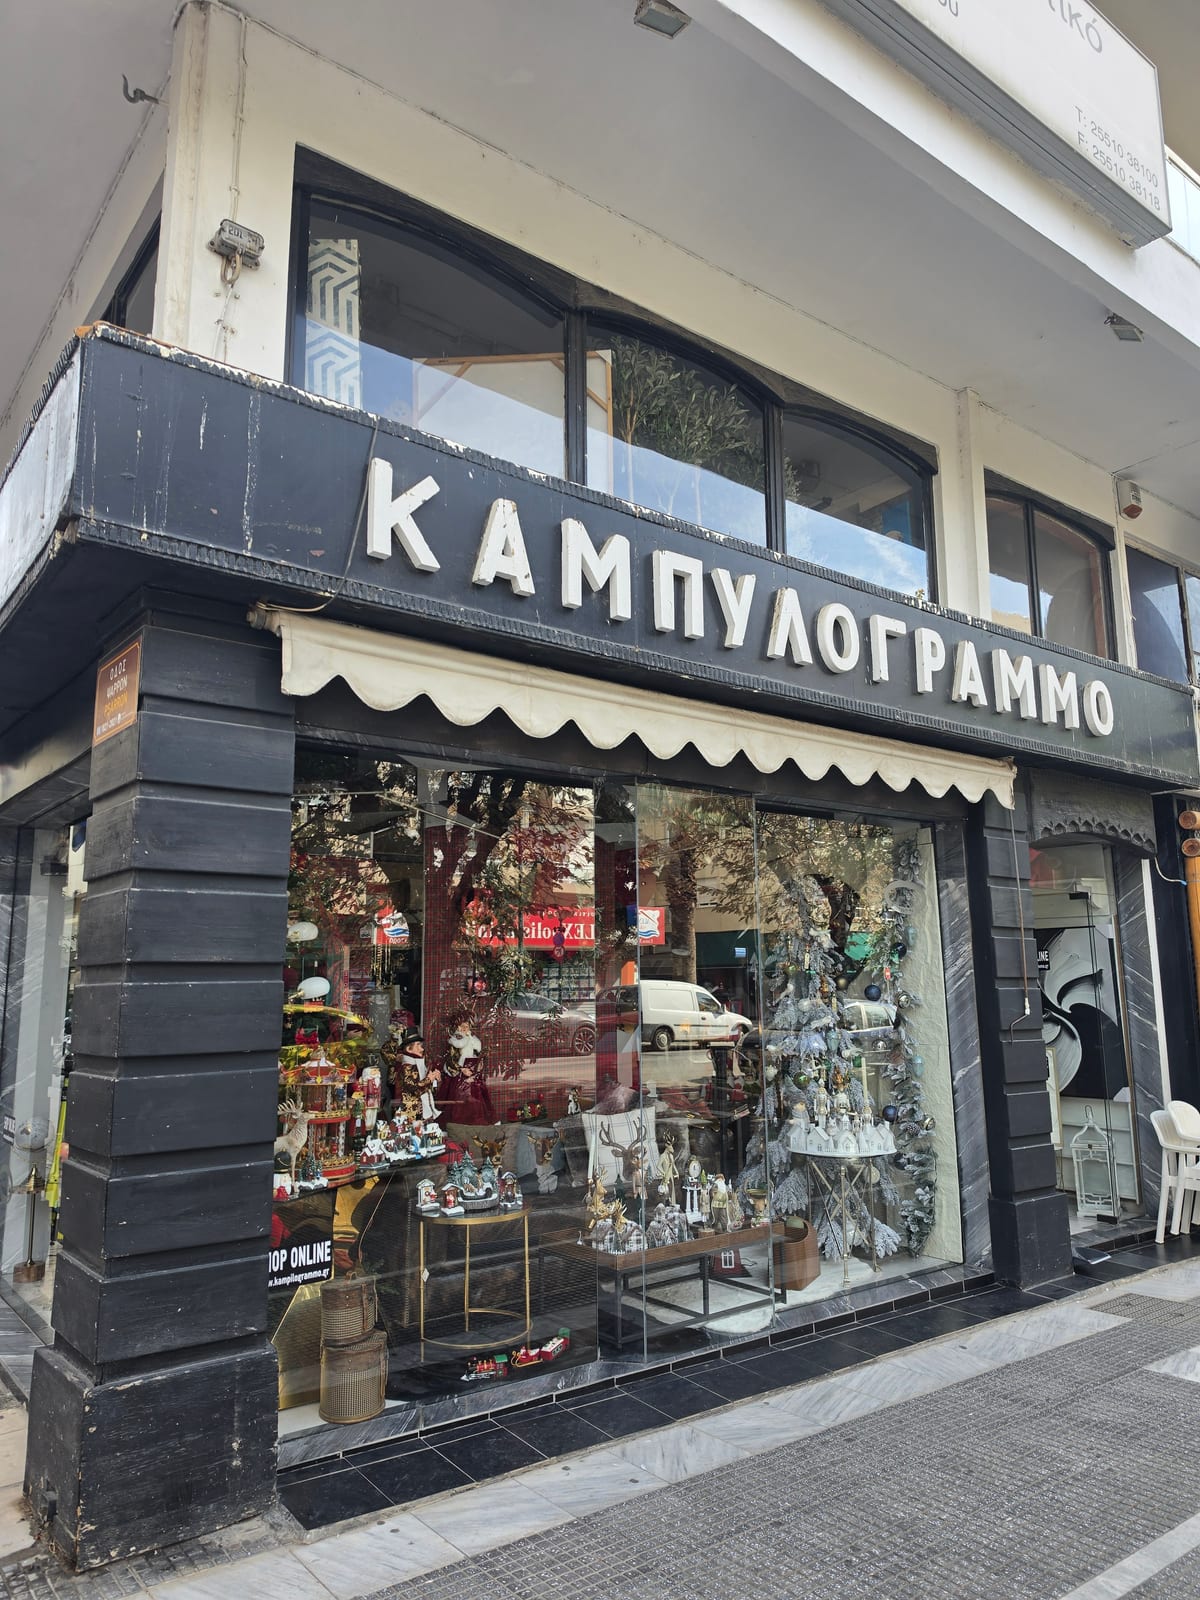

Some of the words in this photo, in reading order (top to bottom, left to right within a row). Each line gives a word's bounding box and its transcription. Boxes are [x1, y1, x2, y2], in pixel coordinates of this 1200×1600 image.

[1073, 105, 1087, 127] T:
[1090, 120, 1124, 158] 25510
[1127, 152, 1158, 188] 38100
[1077, 131, 1089, 152] F:
[1092, 144, 1126, 182] 25510
[1129, 175, 1161, 212] 38118
[366, 456, 1114, 737] ΚΑΜΠΥΛΟΓΡΑΜΜΟ
[109, 658, 127, 681] ΟΔΟΣ
[290, 1240, 332, 1269] ONLINE
